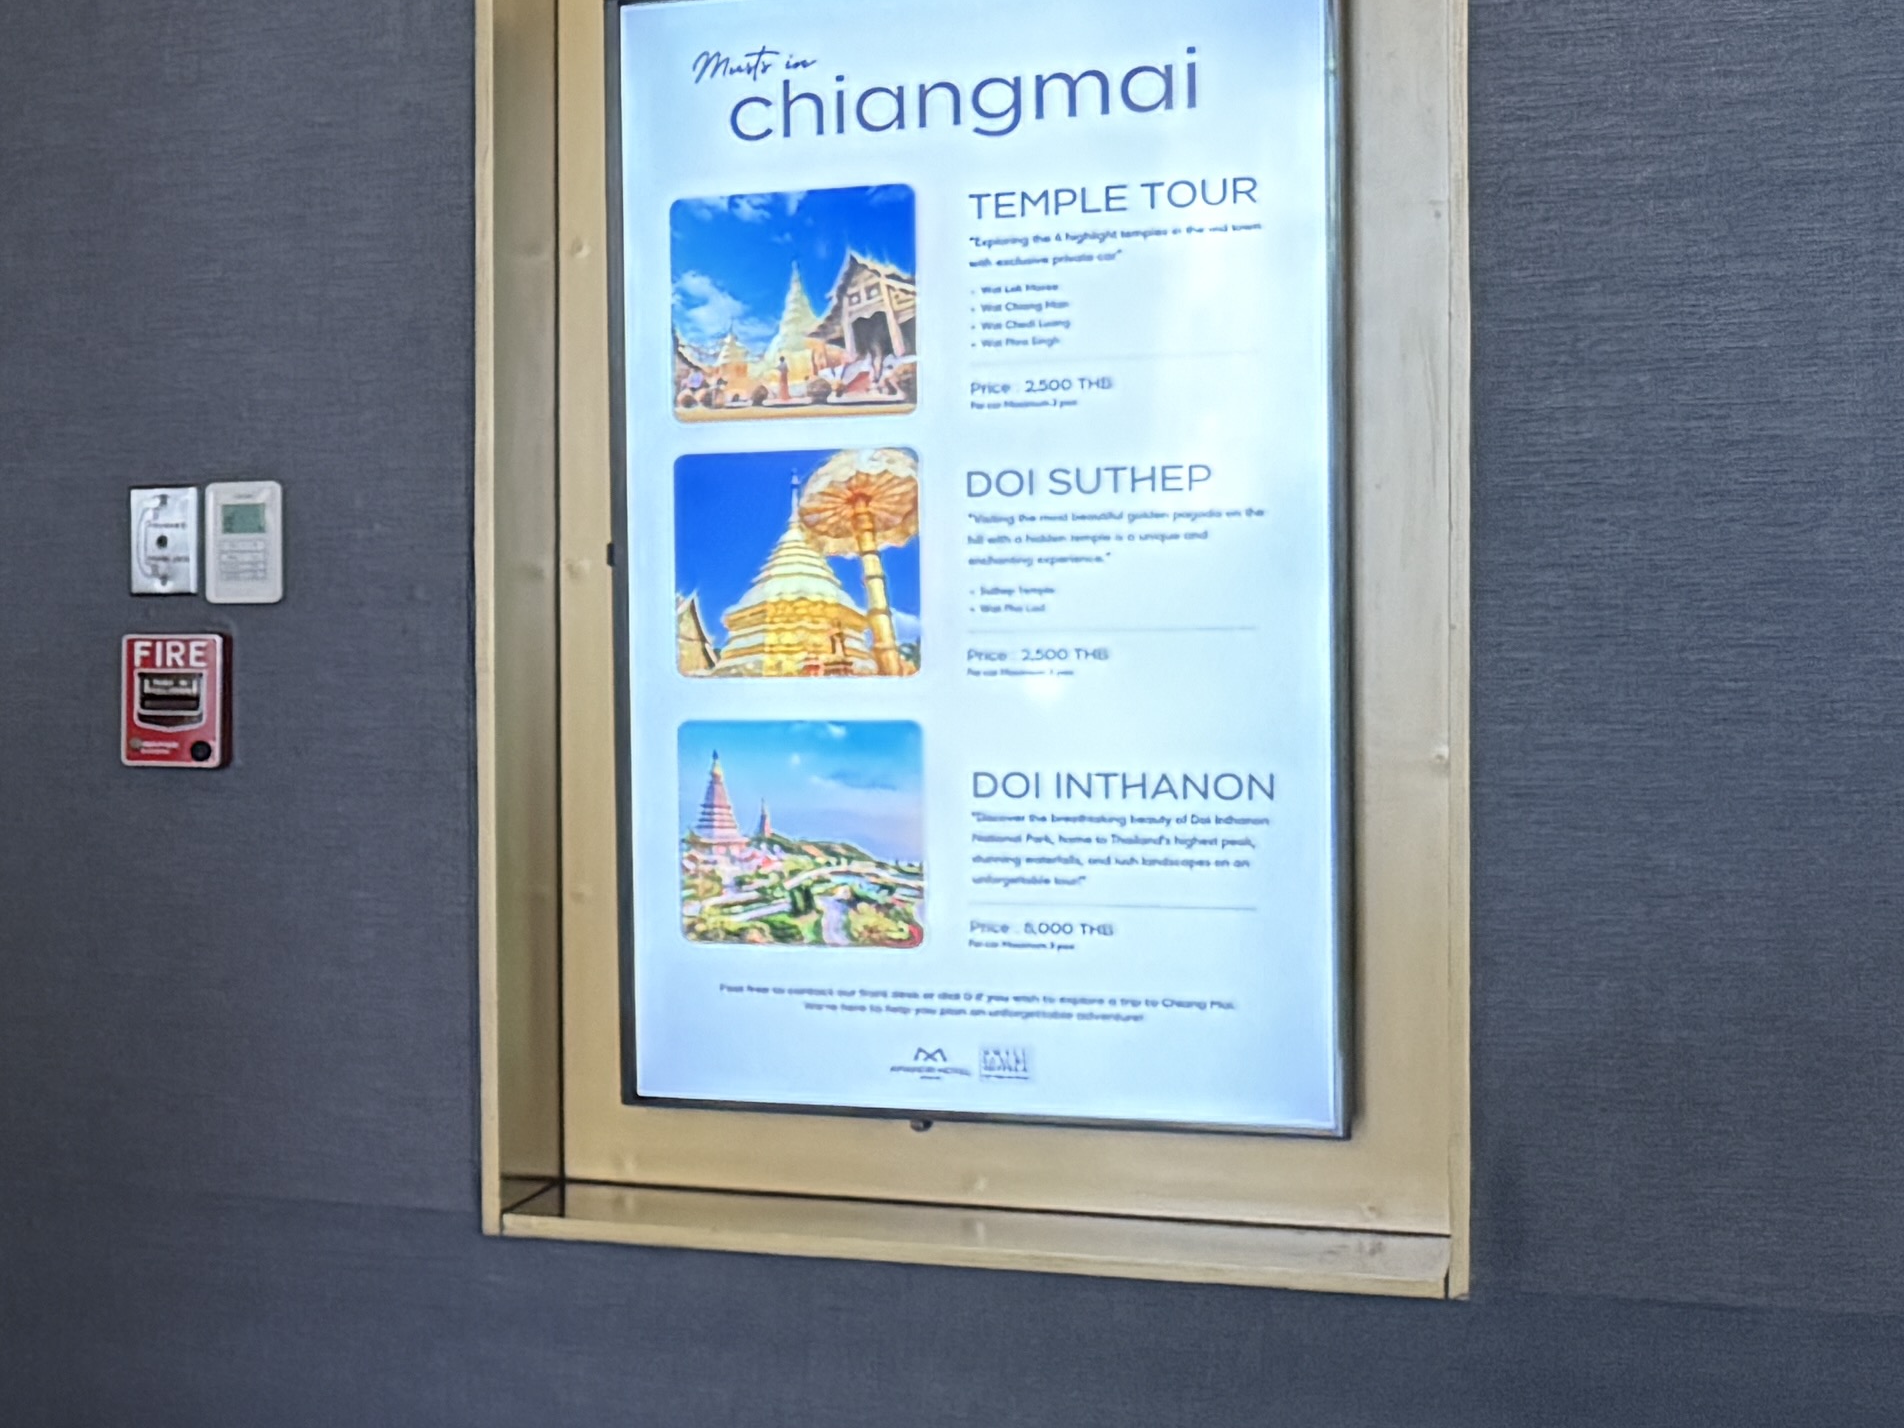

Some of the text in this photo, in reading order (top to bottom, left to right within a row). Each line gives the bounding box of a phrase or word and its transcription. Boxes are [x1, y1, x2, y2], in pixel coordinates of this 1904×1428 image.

[692, 45, 817, 84] Musts in
[730, 45, 1197, 142] chiangmai
[968, 177, 1258, 220] TEMPLE TOUR
[970, 381, 1011, 395] Price
[966, 464, 1212, 498] DOI SUTHEP
[133, 640, 208, 668] FIRE
[967, 648, 1008, 662] Price
[972, 771, 1275, 801] DOI INTHANON
[970, 920, 1010, 934] Price
